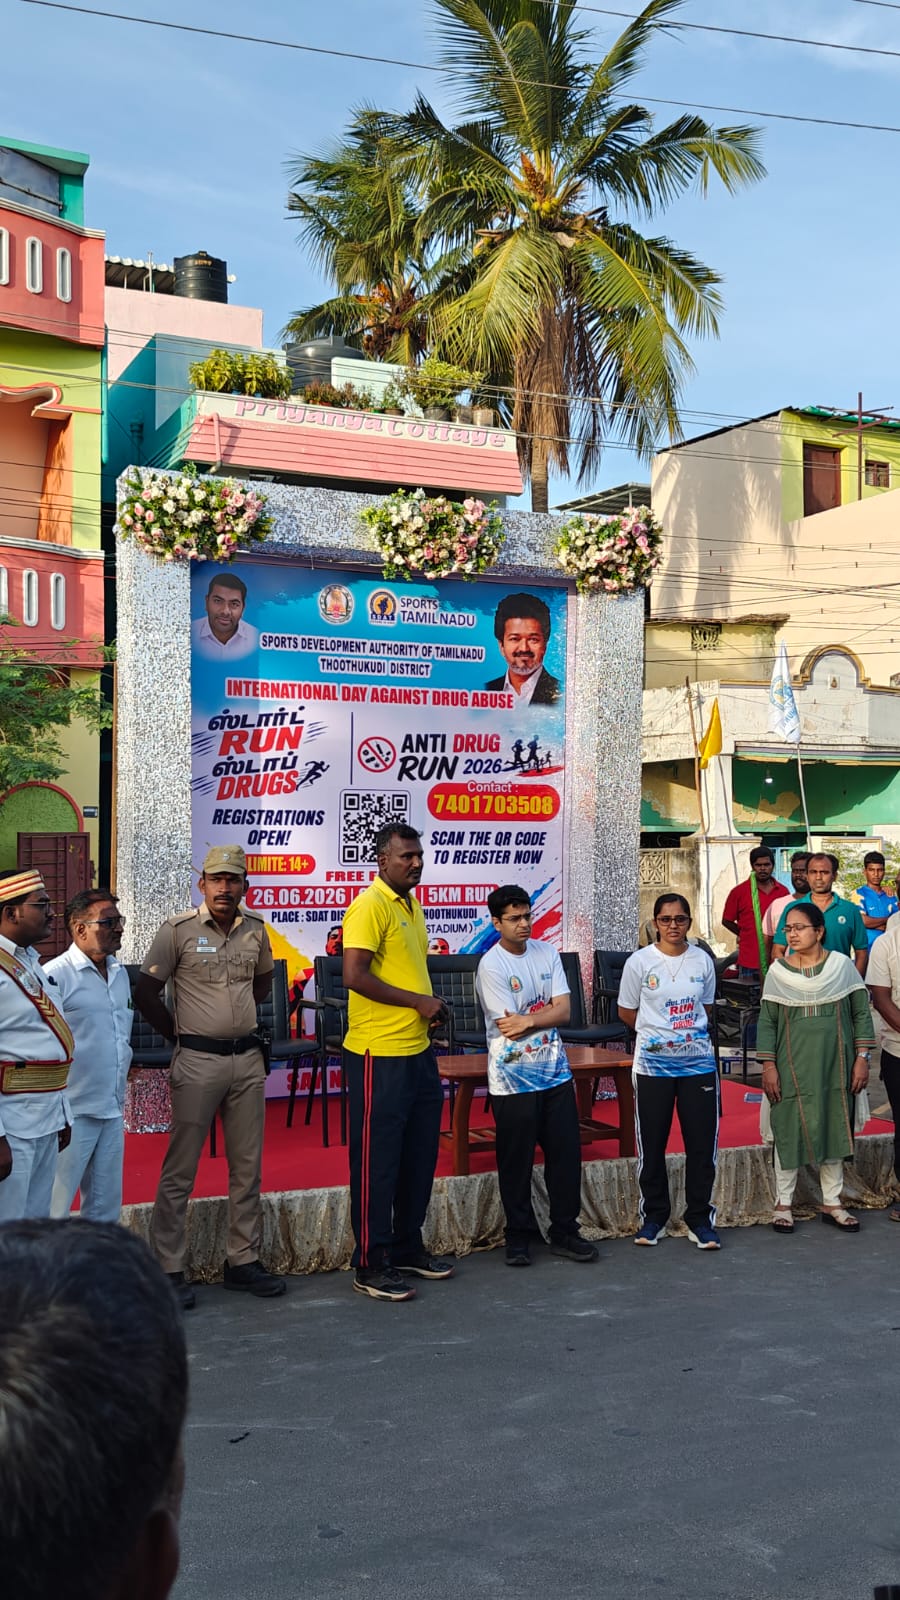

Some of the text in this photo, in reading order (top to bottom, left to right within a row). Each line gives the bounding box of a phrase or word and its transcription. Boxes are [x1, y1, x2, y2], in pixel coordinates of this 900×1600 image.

[387, 420, 506, 447] Cottage
[400, 597, 438, 610] SPORTS
[261, 634, 484, 660] SPORTS DEVELOPMENT AUTHORITY OF TAMILNADU
[320, 658, 430, 676] THOOTHUKUDI DISTRICT
[227, 679, 514, 709] INTERNATIONAL DAY AGAINST DRUG ABUSE
[208, 705, 305, 731] ஸ்டார்ட்
[218, 725, 304, 756] RUN
[400, 733, 501, 754] ANTI DRUG
[211, 751, 298, 777] ஸ்டாப்
[397, 755, 502, 782] RUN 2026
[216, 770, 299, 801] DRUGS
[467, 780, 512, 793] Contact
[433, 794, 554, 815] 7401703508
[212, 808, 325, 826] REGISTRATIONS
[247, 829, 292, 846] OPEN!
[430, 831, 547, 847] SCAN THE QR CODE
[247, 855, 309, 872] LIMITE: 14+
[434, 850, 543, 865] TO REGISTER NOW
[325, 871, 365, 882] FREE
[252, 887, 346, 906] 26.06.2026
[428, 886, 460, 903] 5KM
[271, 911, 300, 923] PLACE
[305, 911, 329, 923] SDAT
[423, 908, 478, 920] HOOTHUKUDI
[670, 1002, 694, 1015] RUN
